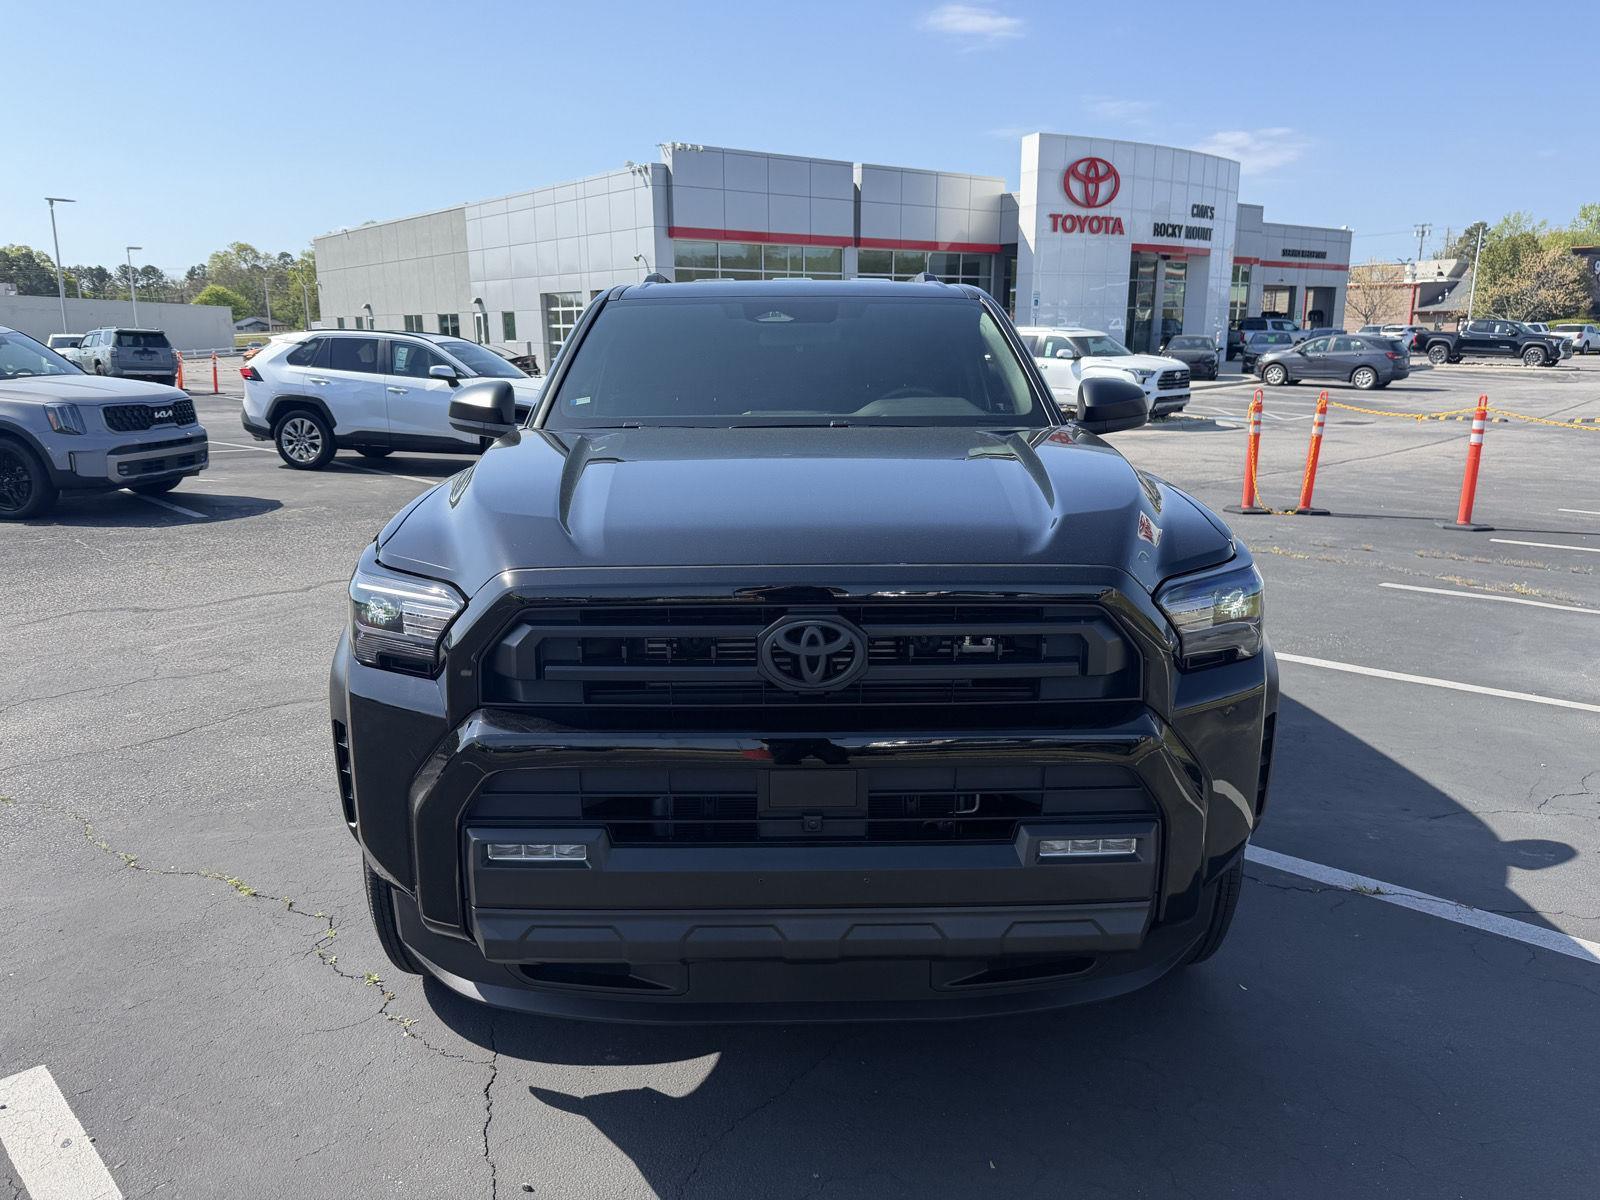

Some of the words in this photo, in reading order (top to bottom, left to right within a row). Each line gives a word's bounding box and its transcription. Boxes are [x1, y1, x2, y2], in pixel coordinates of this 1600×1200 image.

[1049, 213, 1125, 235] TOYOTA
[1153, 222, 1183, 239] ROCKY
[1184, 225, 1213, 242] MOUNT
[154, 410, 174, 418] KIA
